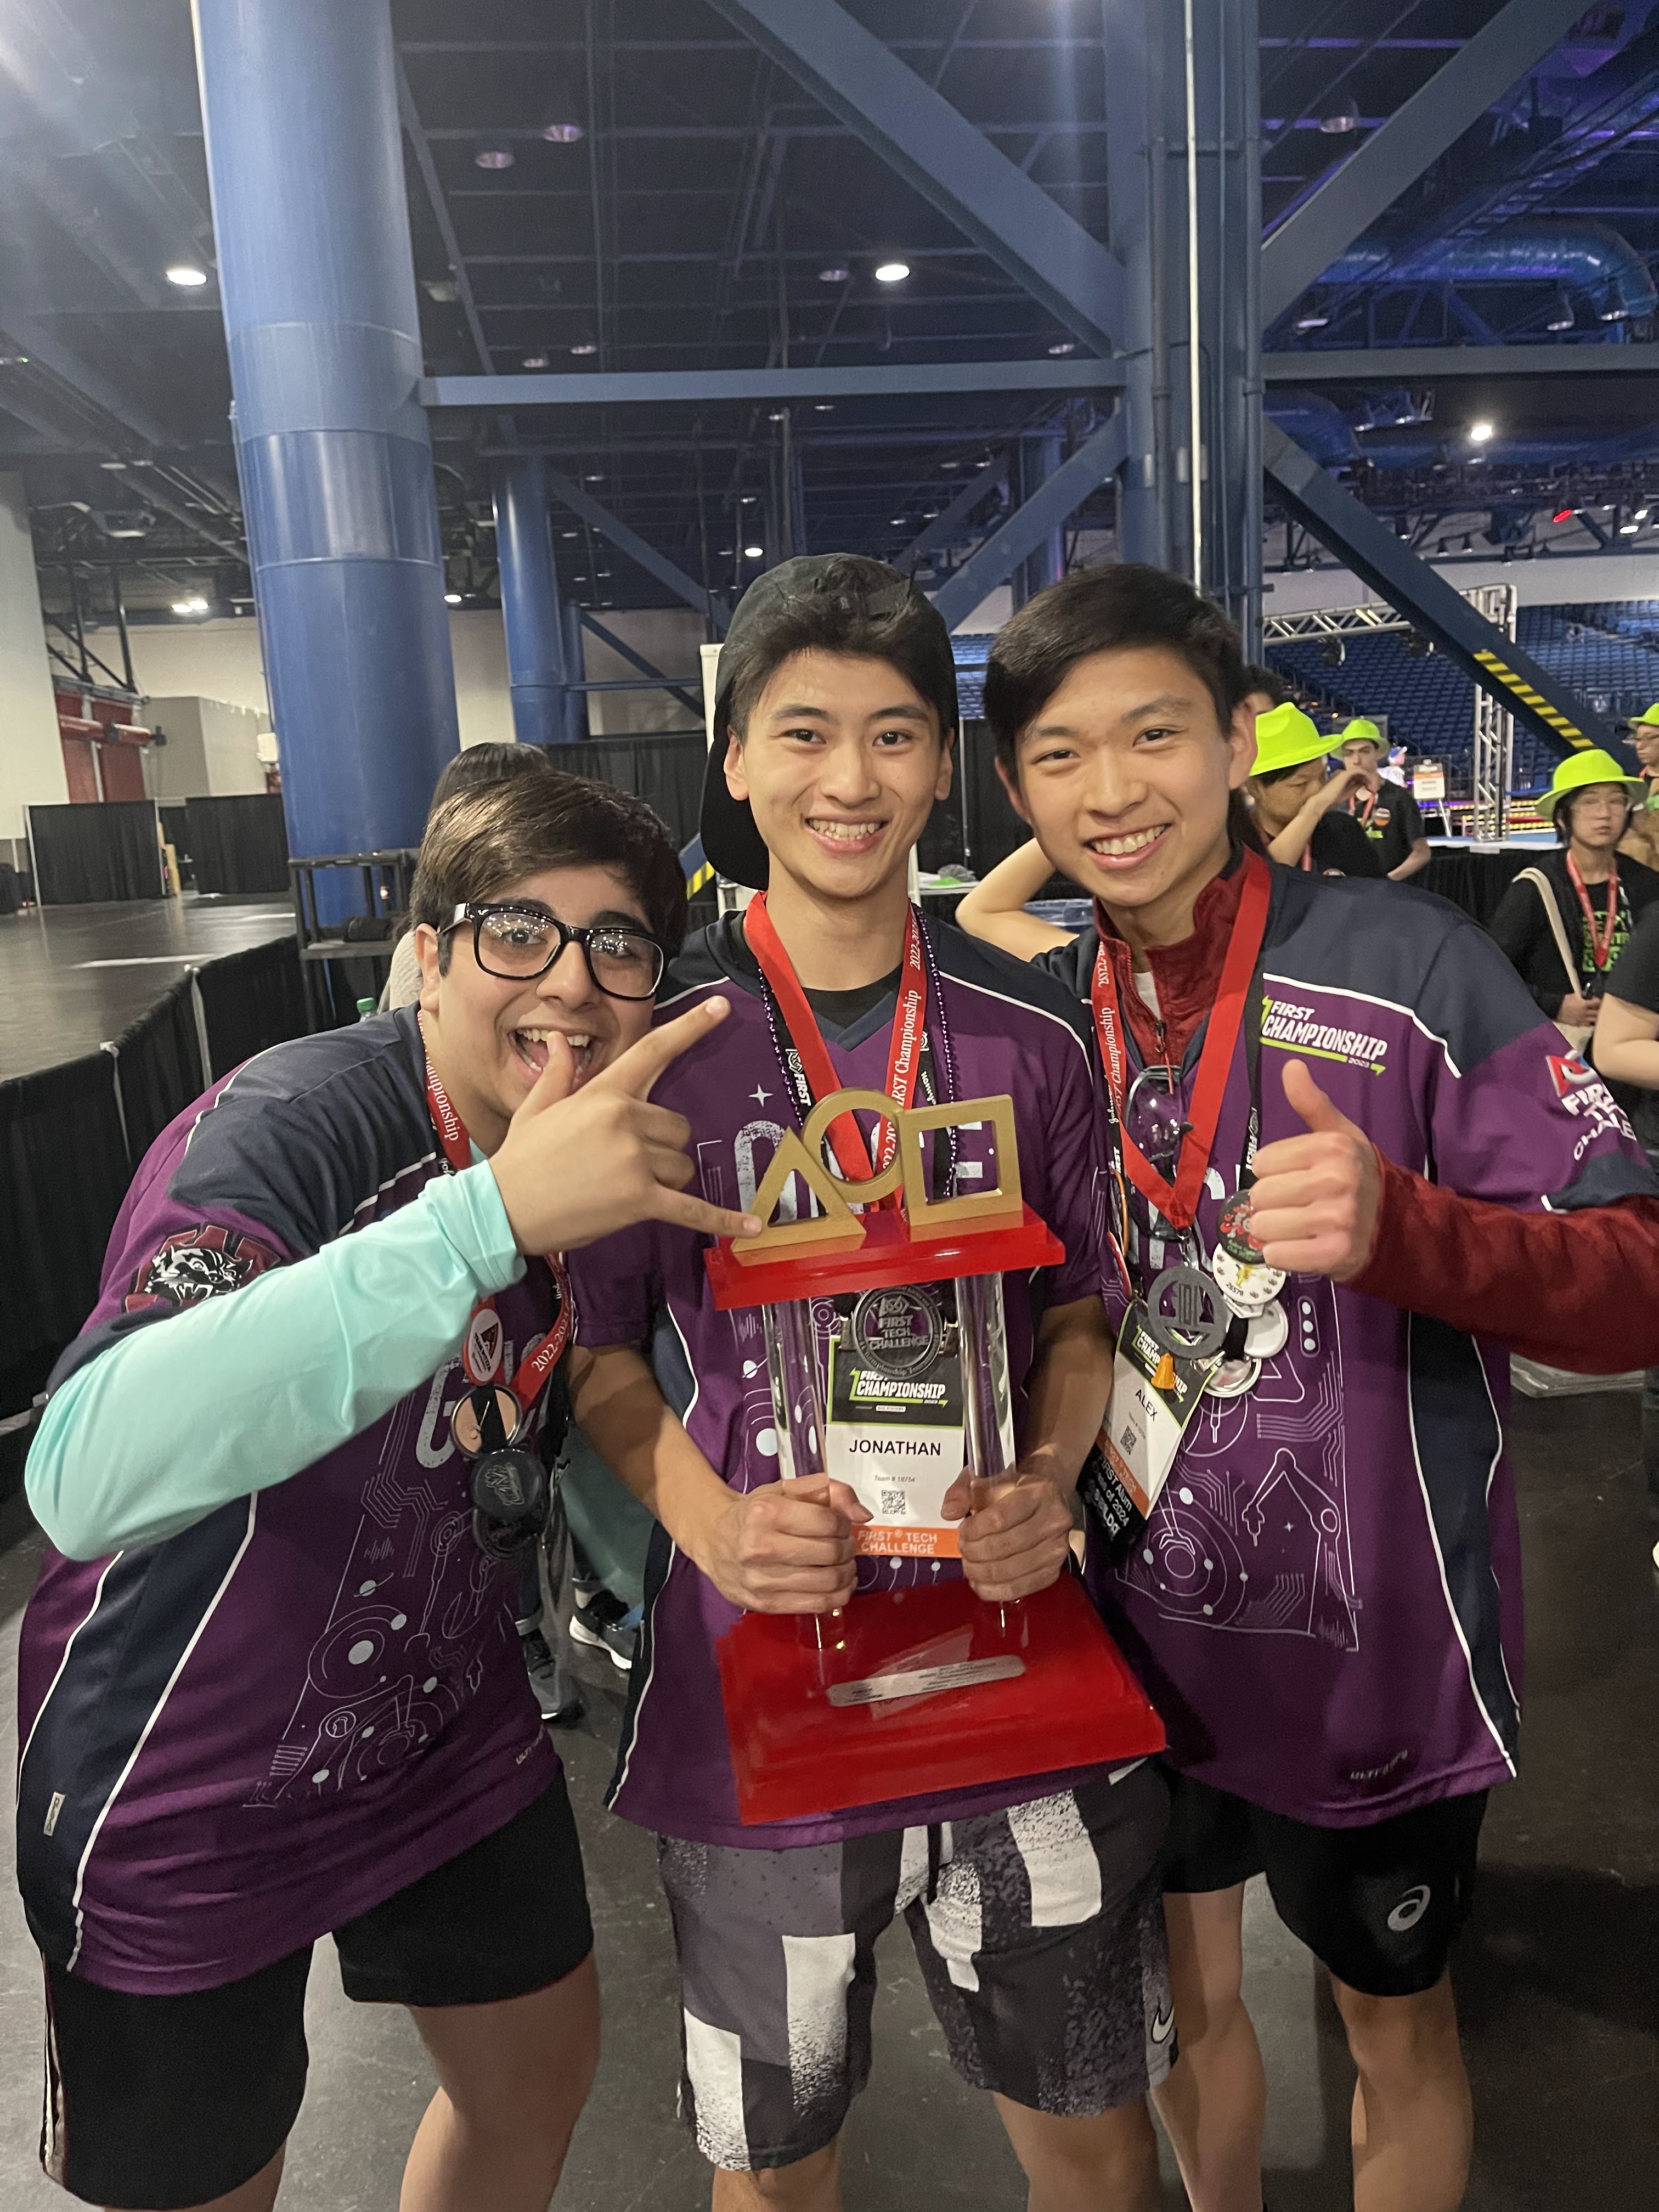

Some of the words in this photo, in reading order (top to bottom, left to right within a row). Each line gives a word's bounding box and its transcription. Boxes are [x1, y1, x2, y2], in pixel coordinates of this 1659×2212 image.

[1271, 1001, 1315, 1021] FIRST
[895, 990, 922, 1074] Championship
[1262, 1015, 1388, 1061] CHAMPIONSHIP
[1099, 1007, 1122, 1084] Championship
[794, 1074, 812, 1106] FIRST
[891, 1074, 907, 1107] IRST
[879, 1315, 913, 1328] FIRST
[882, 1327, 911, 1338] TECH
[870, 1335, 929, 1350] CHALLENGE
[856, 1380, 946, 1398] CHAMPIONSHIP
[1135, 1389, 1158, 1421] ALEX
[849, 1440, 941, 1456] JONATHAN
[905, 1532, 938, 1543] TECH
[861, 1542, 935, 1554] CHALLENGE
